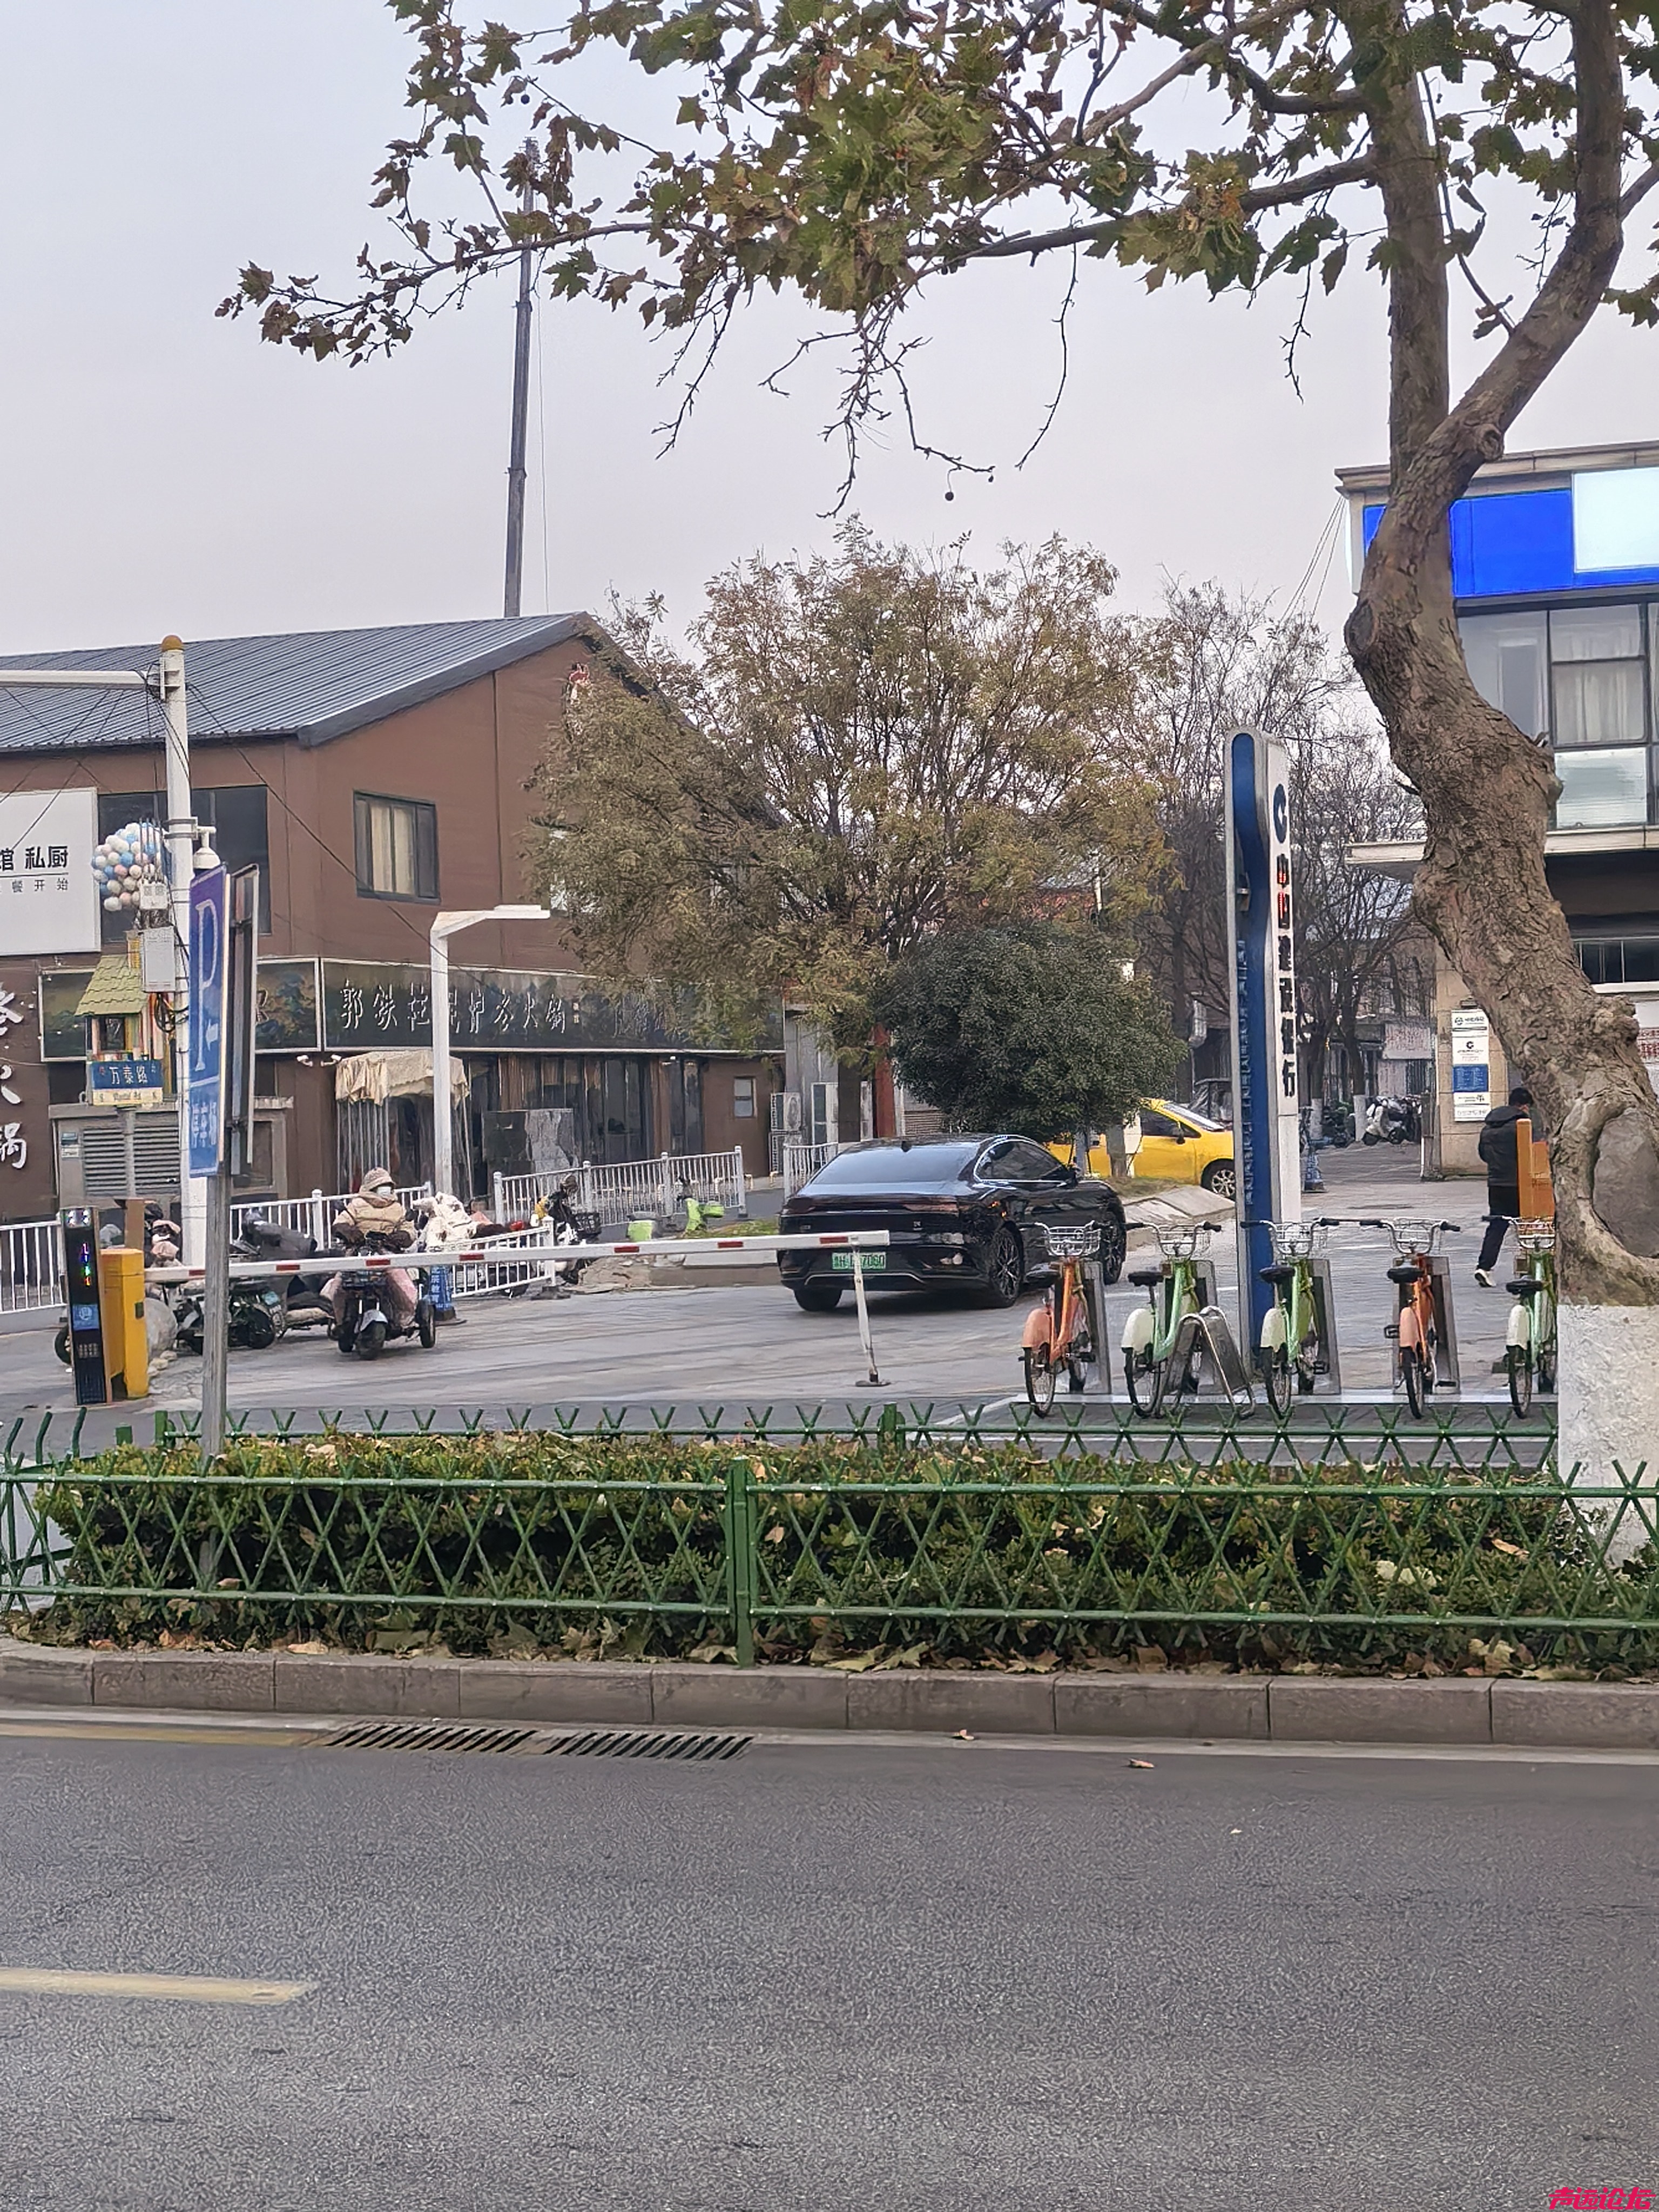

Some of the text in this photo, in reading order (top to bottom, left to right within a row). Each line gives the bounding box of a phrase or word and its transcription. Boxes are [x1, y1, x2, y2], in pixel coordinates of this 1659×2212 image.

[25, 846, 68, 869] 私厨
[195, 899, 218, 1071] P
[109, 1064, 148, 1084] 万泰路
